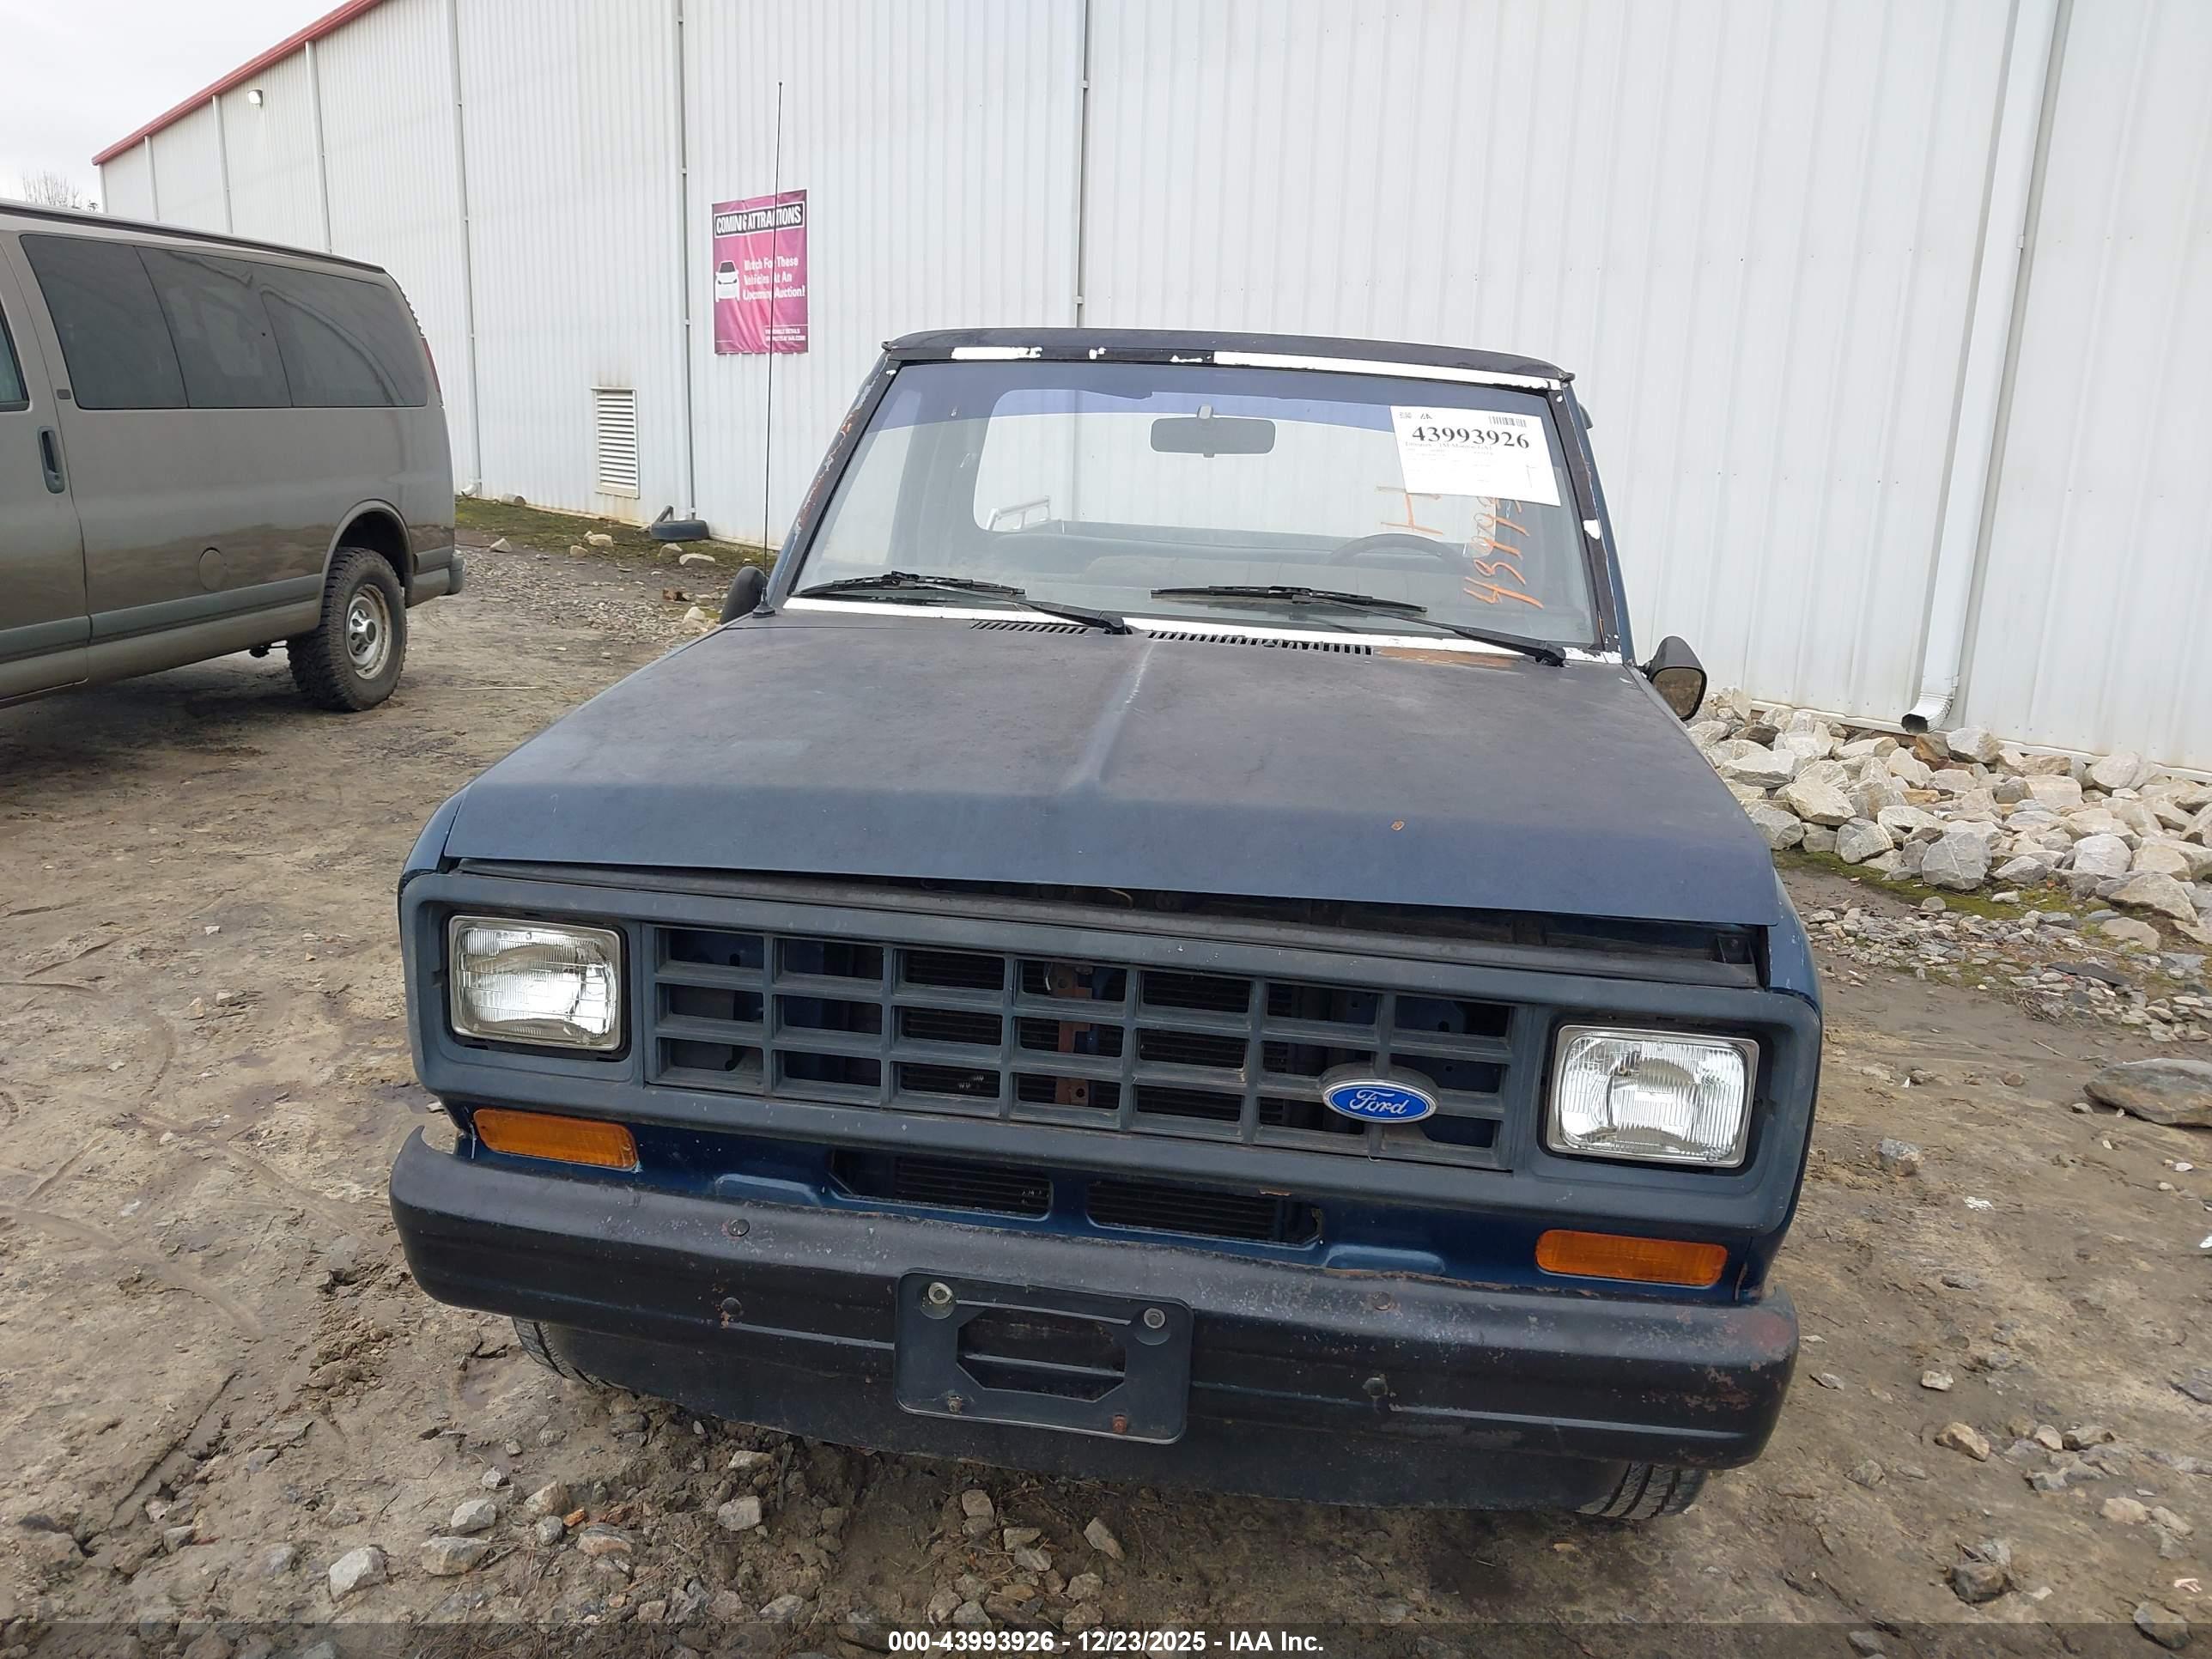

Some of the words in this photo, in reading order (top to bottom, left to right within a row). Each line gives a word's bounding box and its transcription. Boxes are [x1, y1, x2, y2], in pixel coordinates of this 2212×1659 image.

[777, 255, 799, 268] These
[782, 270, 793, 283] An
[775, 284, 805, 299] Auction!
[1412, 426, 1530, 449] 43993926
[1349, 1089, 1409, 1115] Ford
